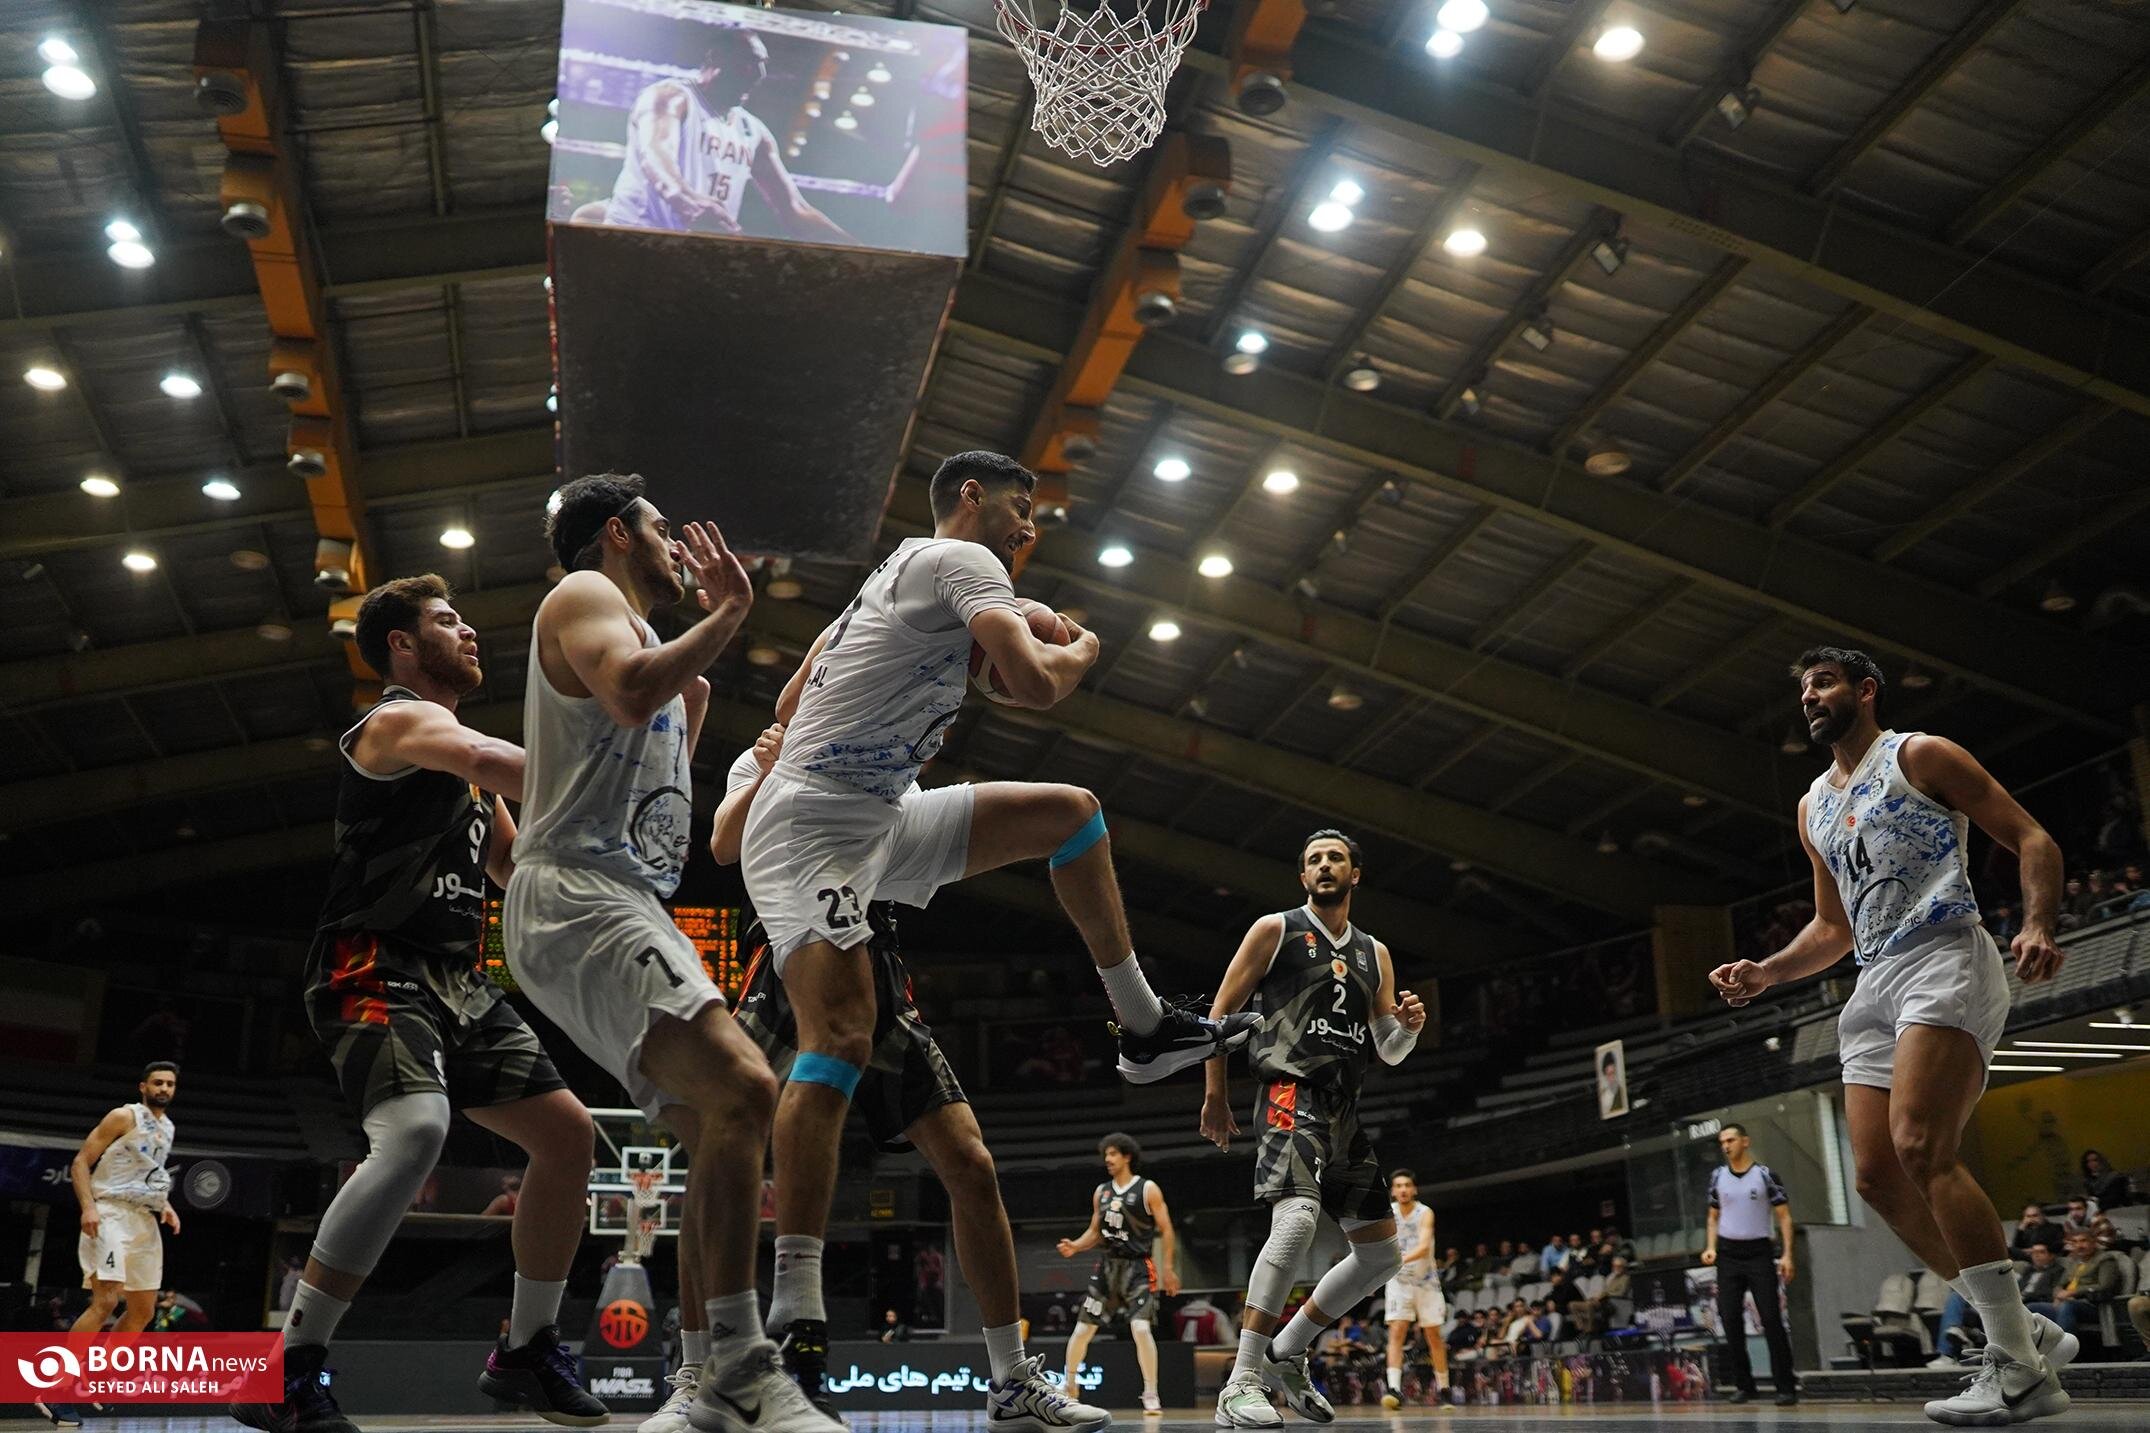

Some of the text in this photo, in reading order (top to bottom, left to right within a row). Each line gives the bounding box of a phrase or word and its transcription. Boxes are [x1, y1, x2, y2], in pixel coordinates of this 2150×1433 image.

[700, 132, 752, 167] IRAN
[709, 172, 731, 201] 15
[1843, 836, 1875, 883] 14
[817, 886, 862, 929] 23
[634, 946, 685, 989] 7
[1332, 983, 1347, 1015] 2
[106, 1251, 115, 1268] 4
[828, 1364, 875, 1393] ملی
[878, 1364, 929, 1393] های
[931, 1366, 971, 1395] تیم
